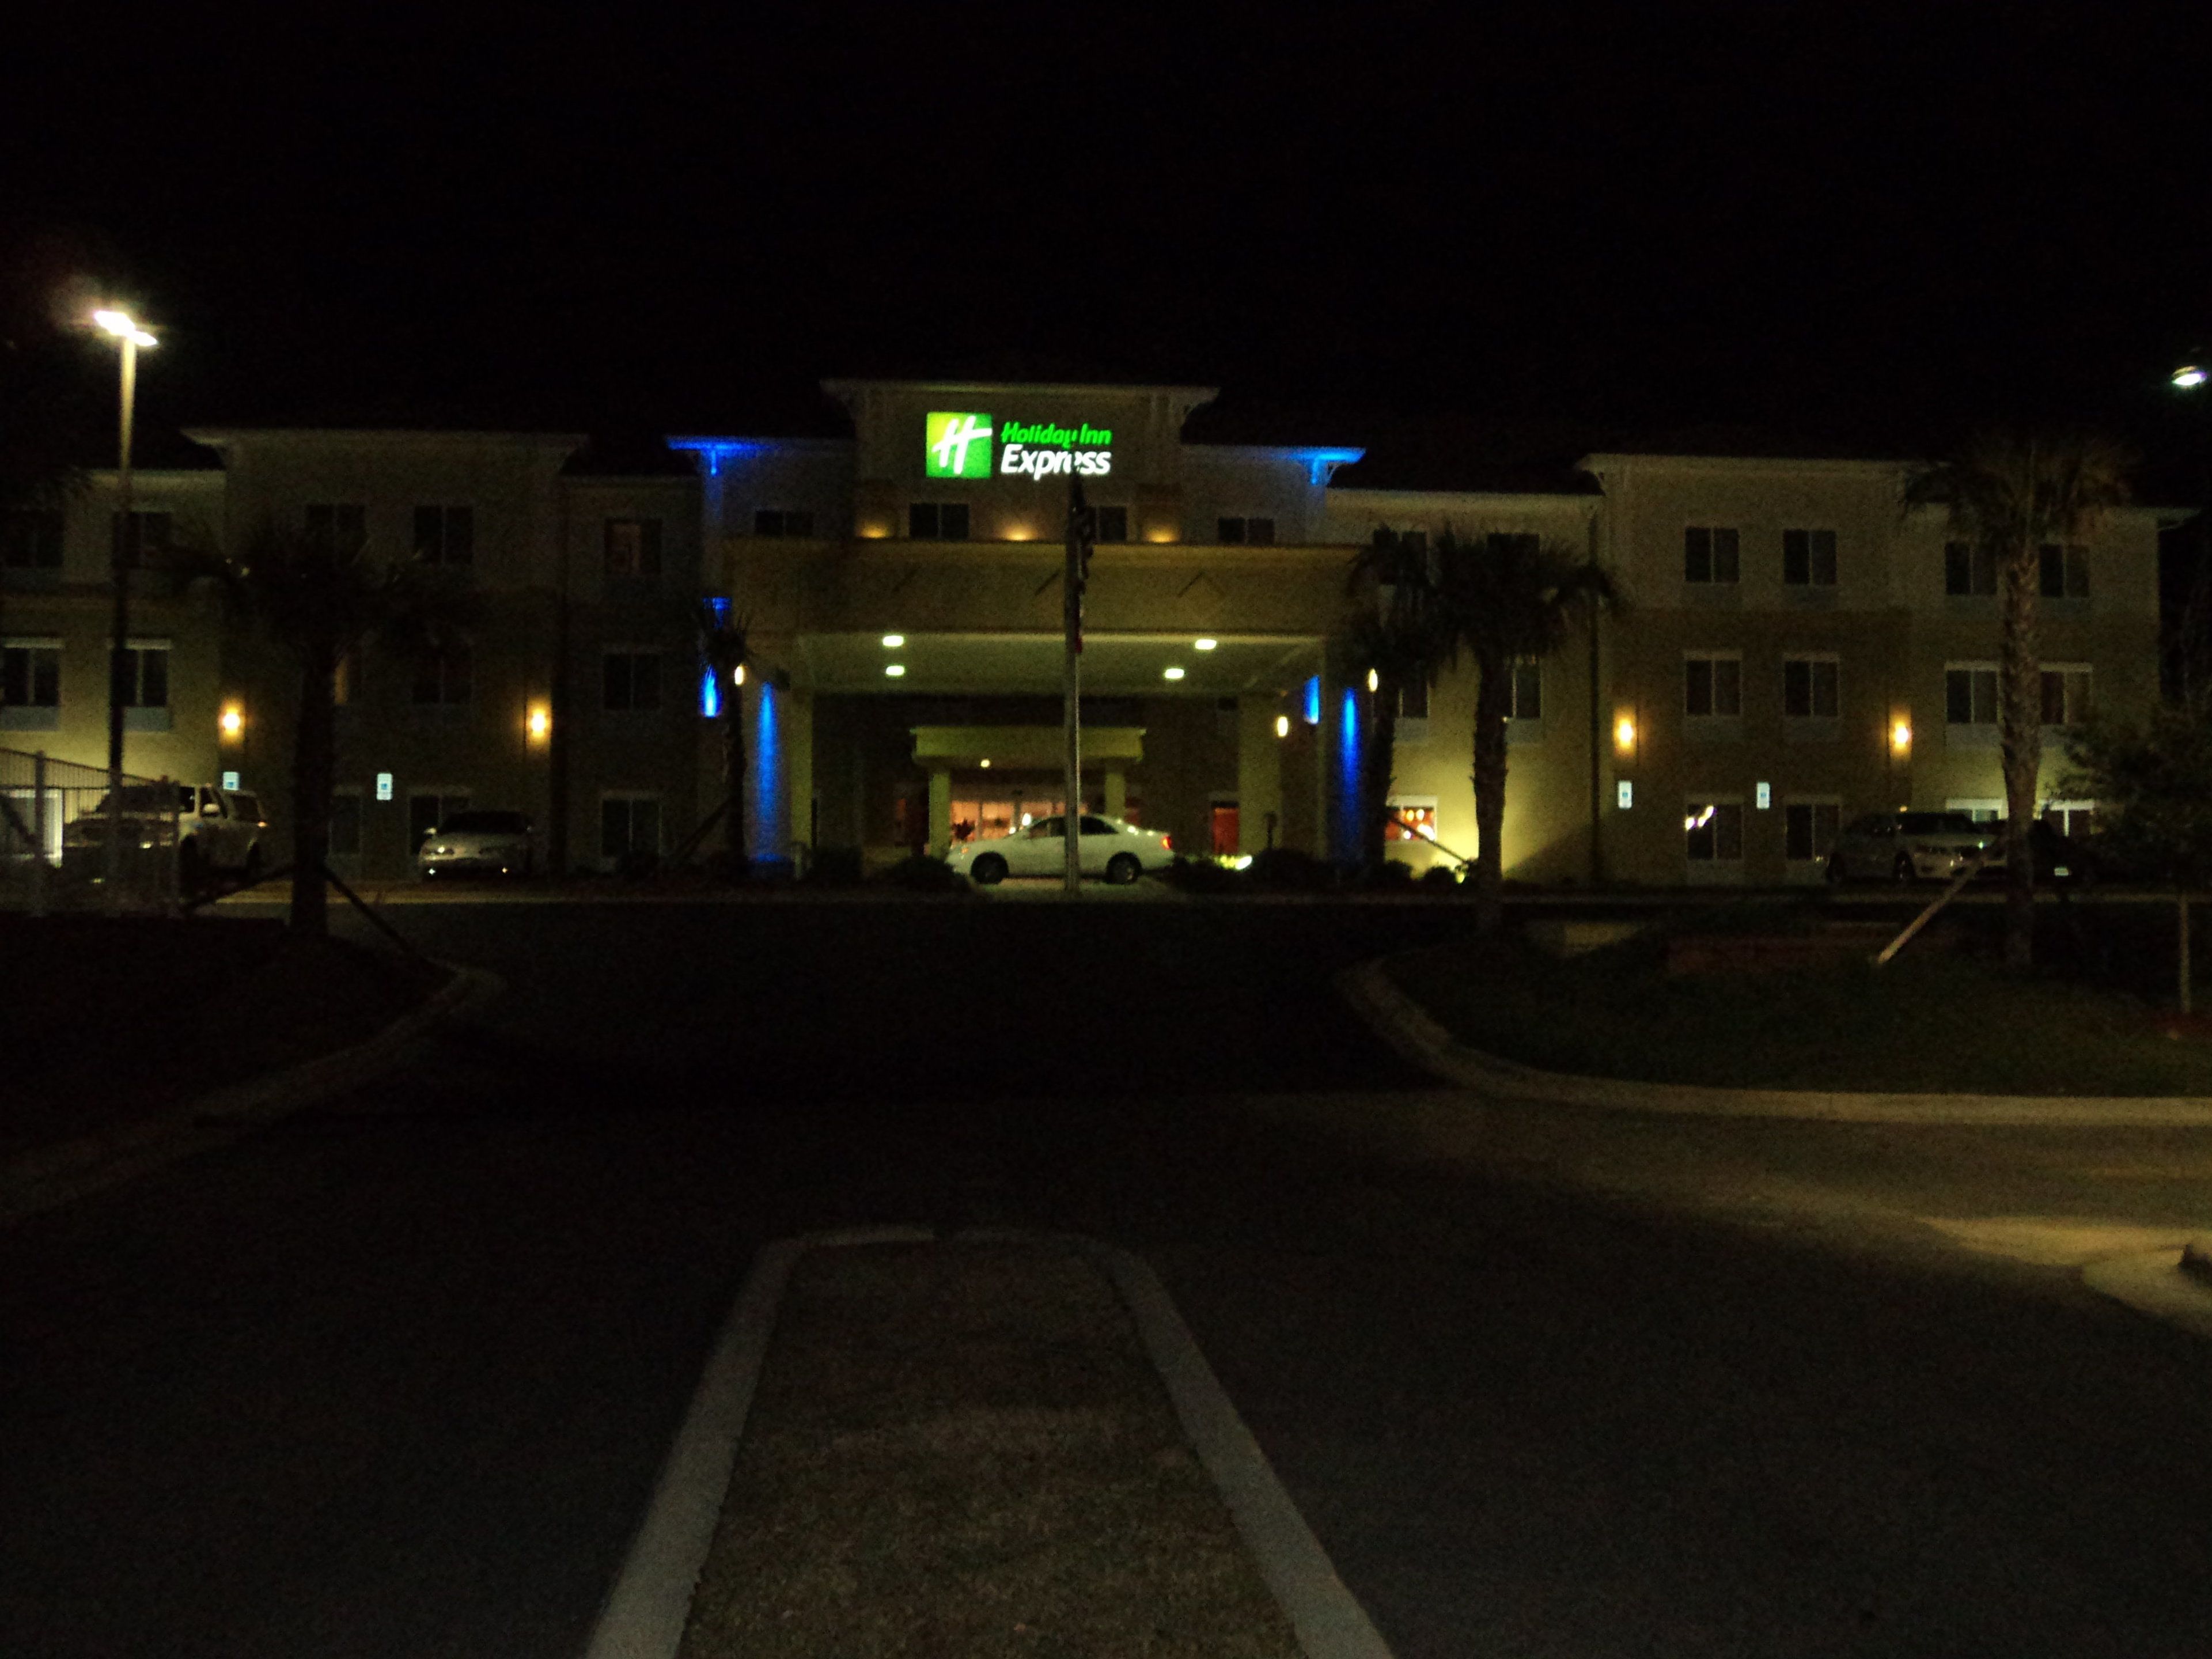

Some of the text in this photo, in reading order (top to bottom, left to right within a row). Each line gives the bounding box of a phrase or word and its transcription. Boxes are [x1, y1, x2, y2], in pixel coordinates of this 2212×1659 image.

[931, 415, 993, 475] H
[1000, 422, 1112, 449] Holiday Inn
